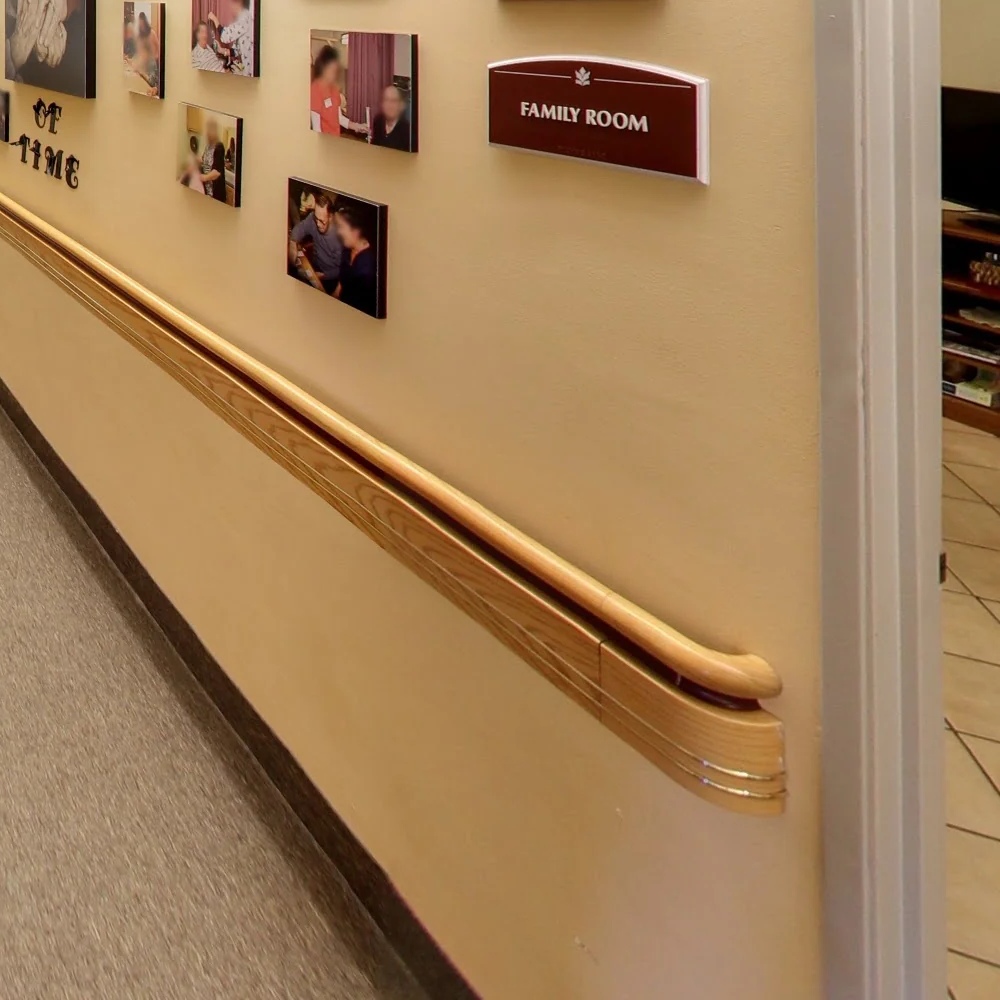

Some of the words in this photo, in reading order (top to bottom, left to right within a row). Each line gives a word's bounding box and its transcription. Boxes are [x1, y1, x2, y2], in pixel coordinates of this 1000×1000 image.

[32, 97, 63, 135] OF
[520, 101, 580, 123] FAMILY
[585, 108, 649, 132] ROOM
[9, 133, 80, 189] TIME
